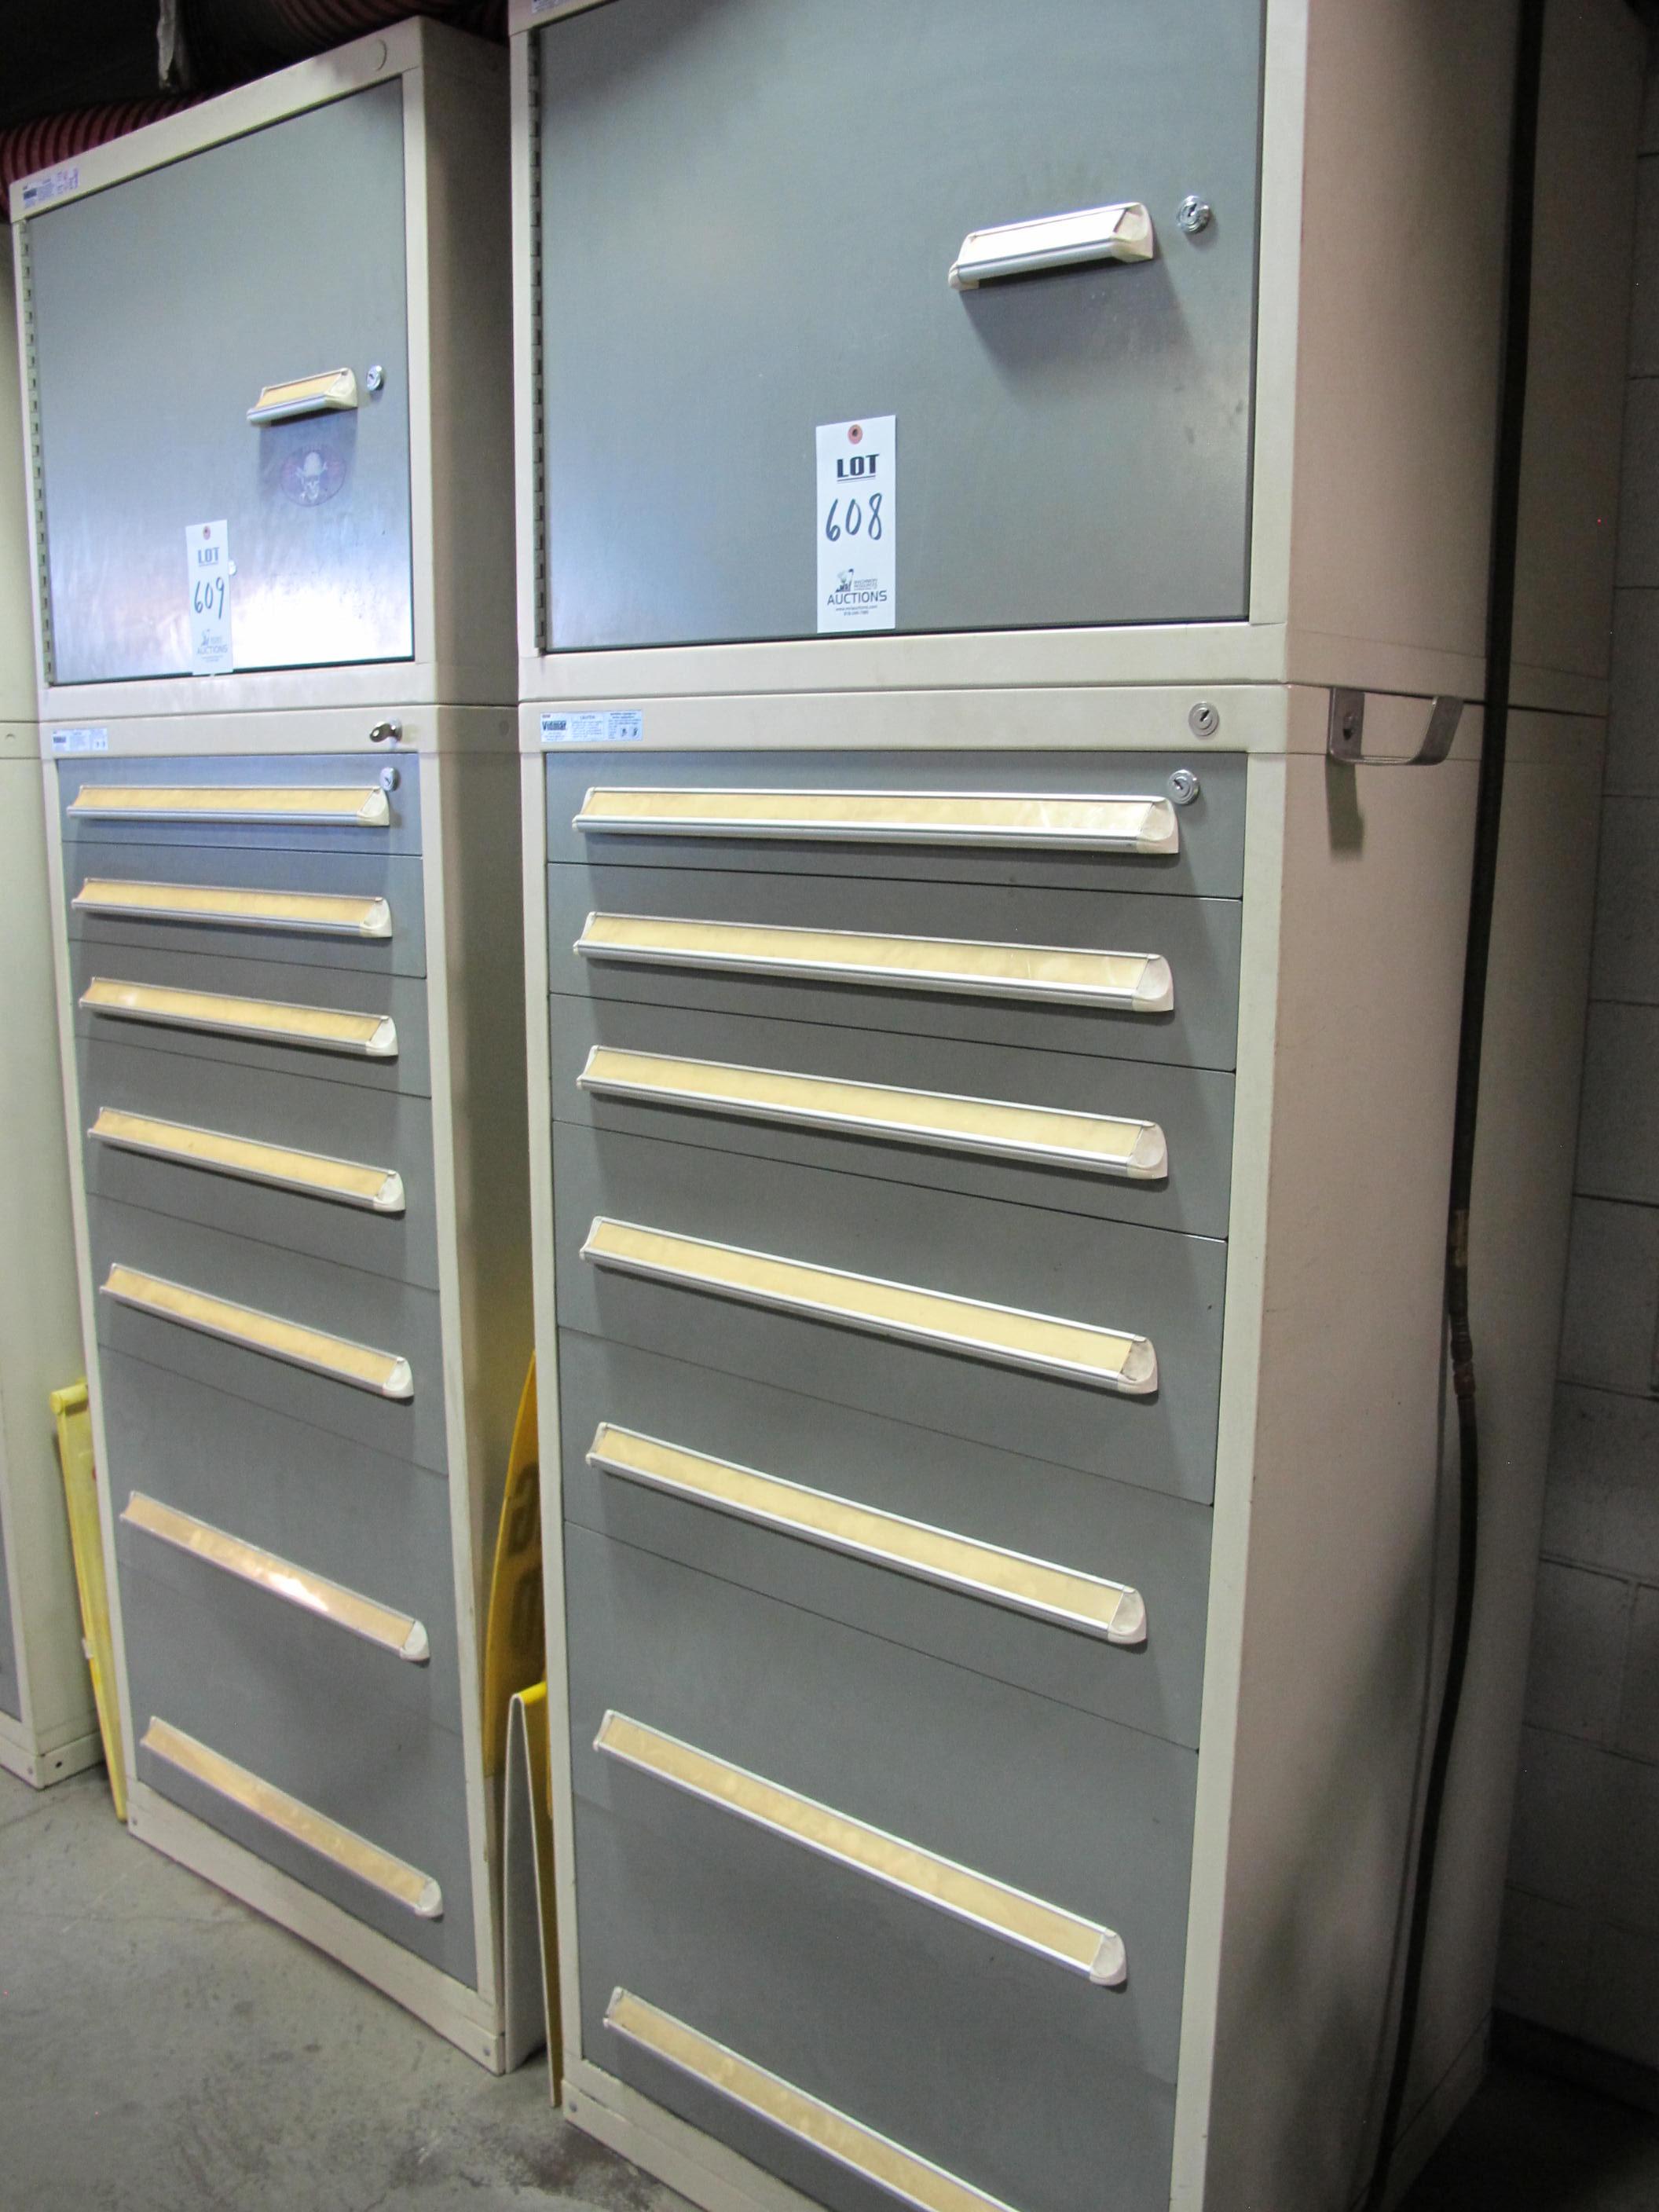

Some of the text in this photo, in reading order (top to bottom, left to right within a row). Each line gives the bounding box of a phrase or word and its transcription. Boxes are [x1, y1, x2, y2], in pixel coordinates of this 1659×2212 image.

[837, 453, 881, 478] LOT
[826, 493, 882, 542] 608
[198, 548, 219, 563] LOT
[194, 577, 225, 620] 609
[827, 590, 888, 606] AUCTIONS
